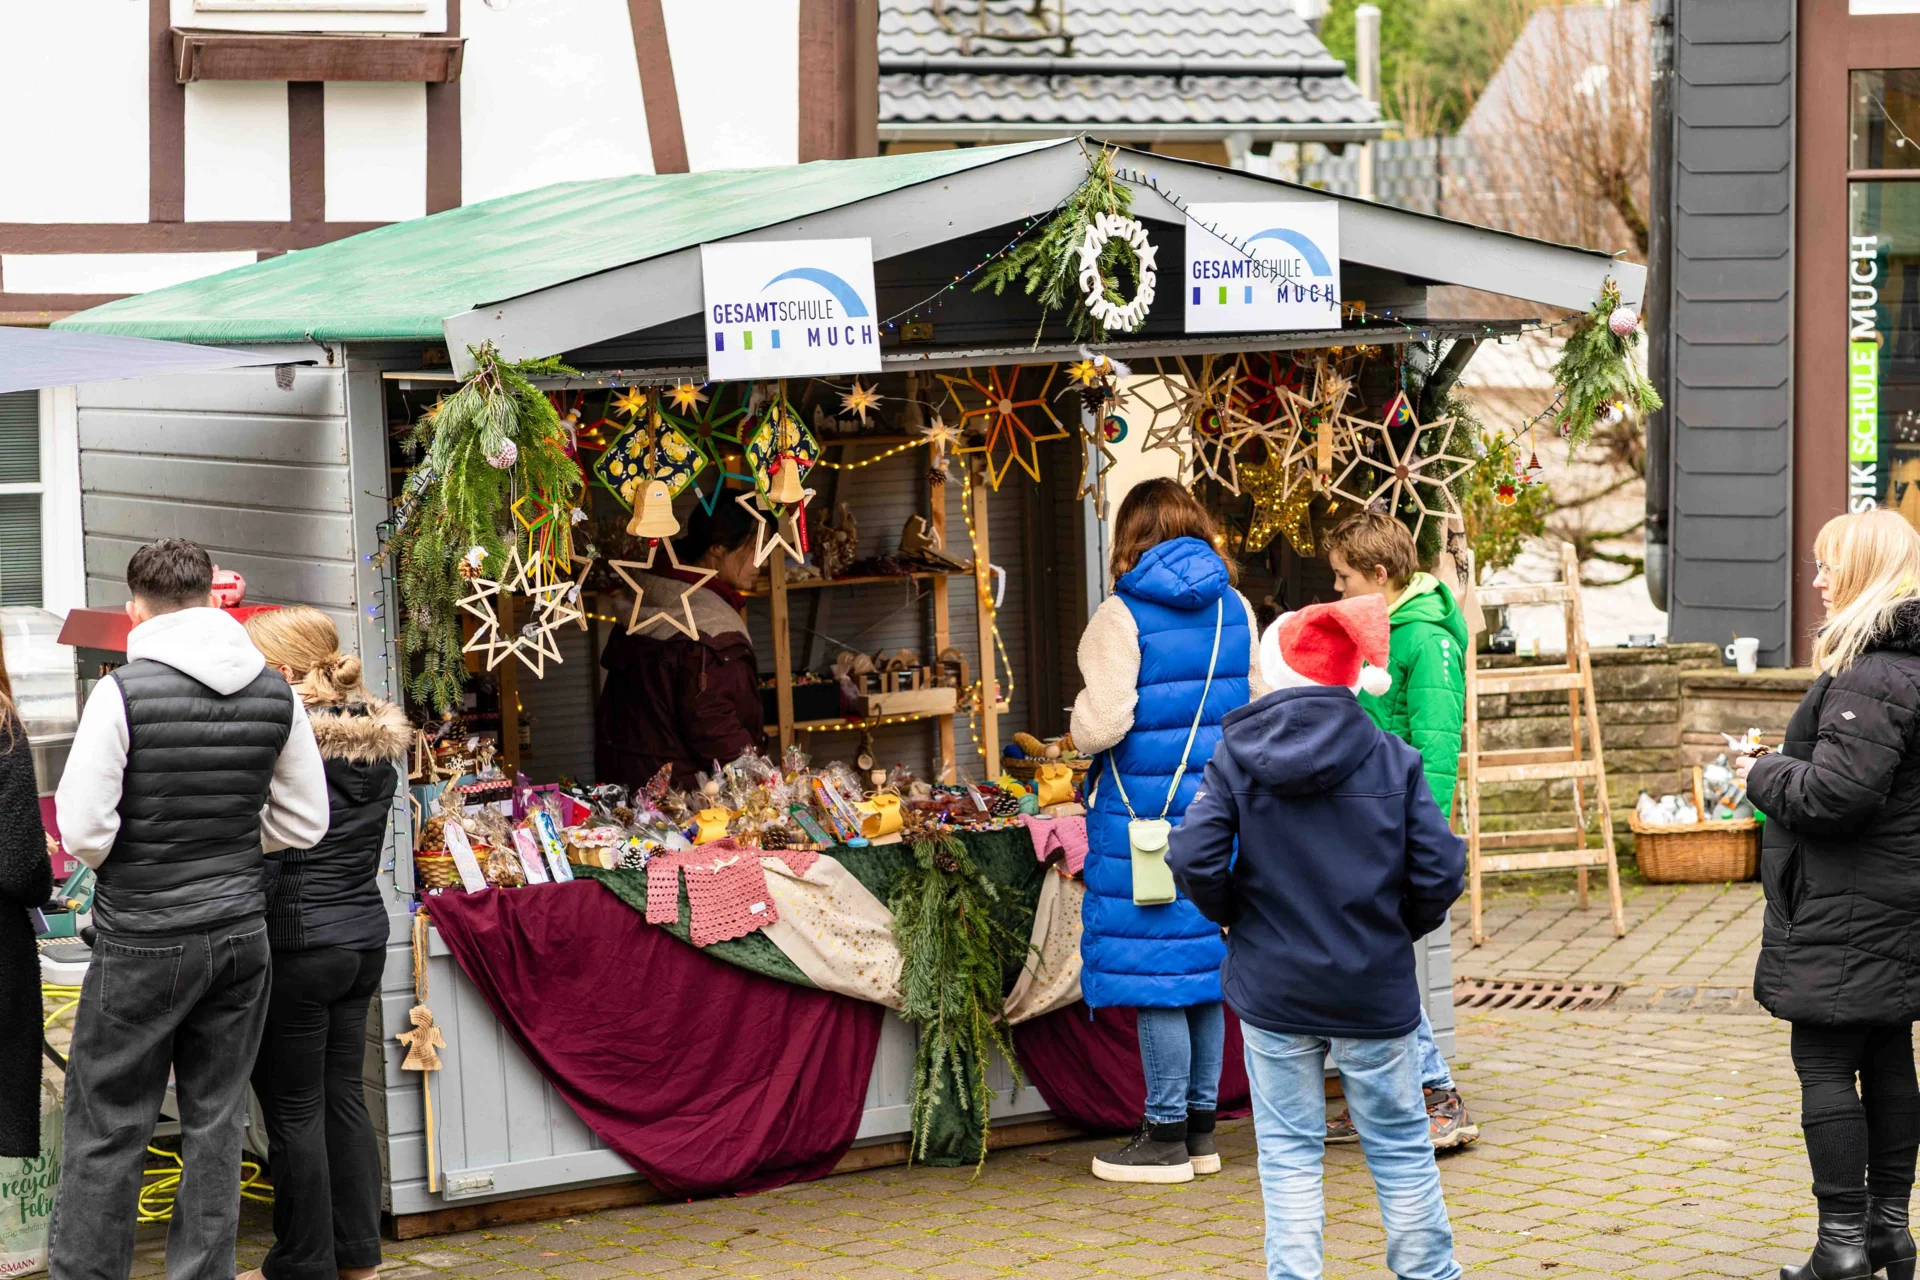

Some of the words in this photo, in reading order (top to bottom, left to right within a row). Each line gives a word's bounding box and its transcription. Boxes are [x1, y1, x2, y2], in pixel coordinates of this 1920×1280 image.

[1085, 211, 1149, 250] Merry
[1192, 258, 1302, 280] GESAMTSCHULE
[1277, 284, 1335, 304] MUCH
[1850, 235, 1878, 339] MUCH
[713, 299, 834, 325] GESAMTSCHULE
[807, 324, 873, 347] MUCH
[1852, 349, 1877, 456] SCHULE
[0, 1257, 35, 1273] SMANN
